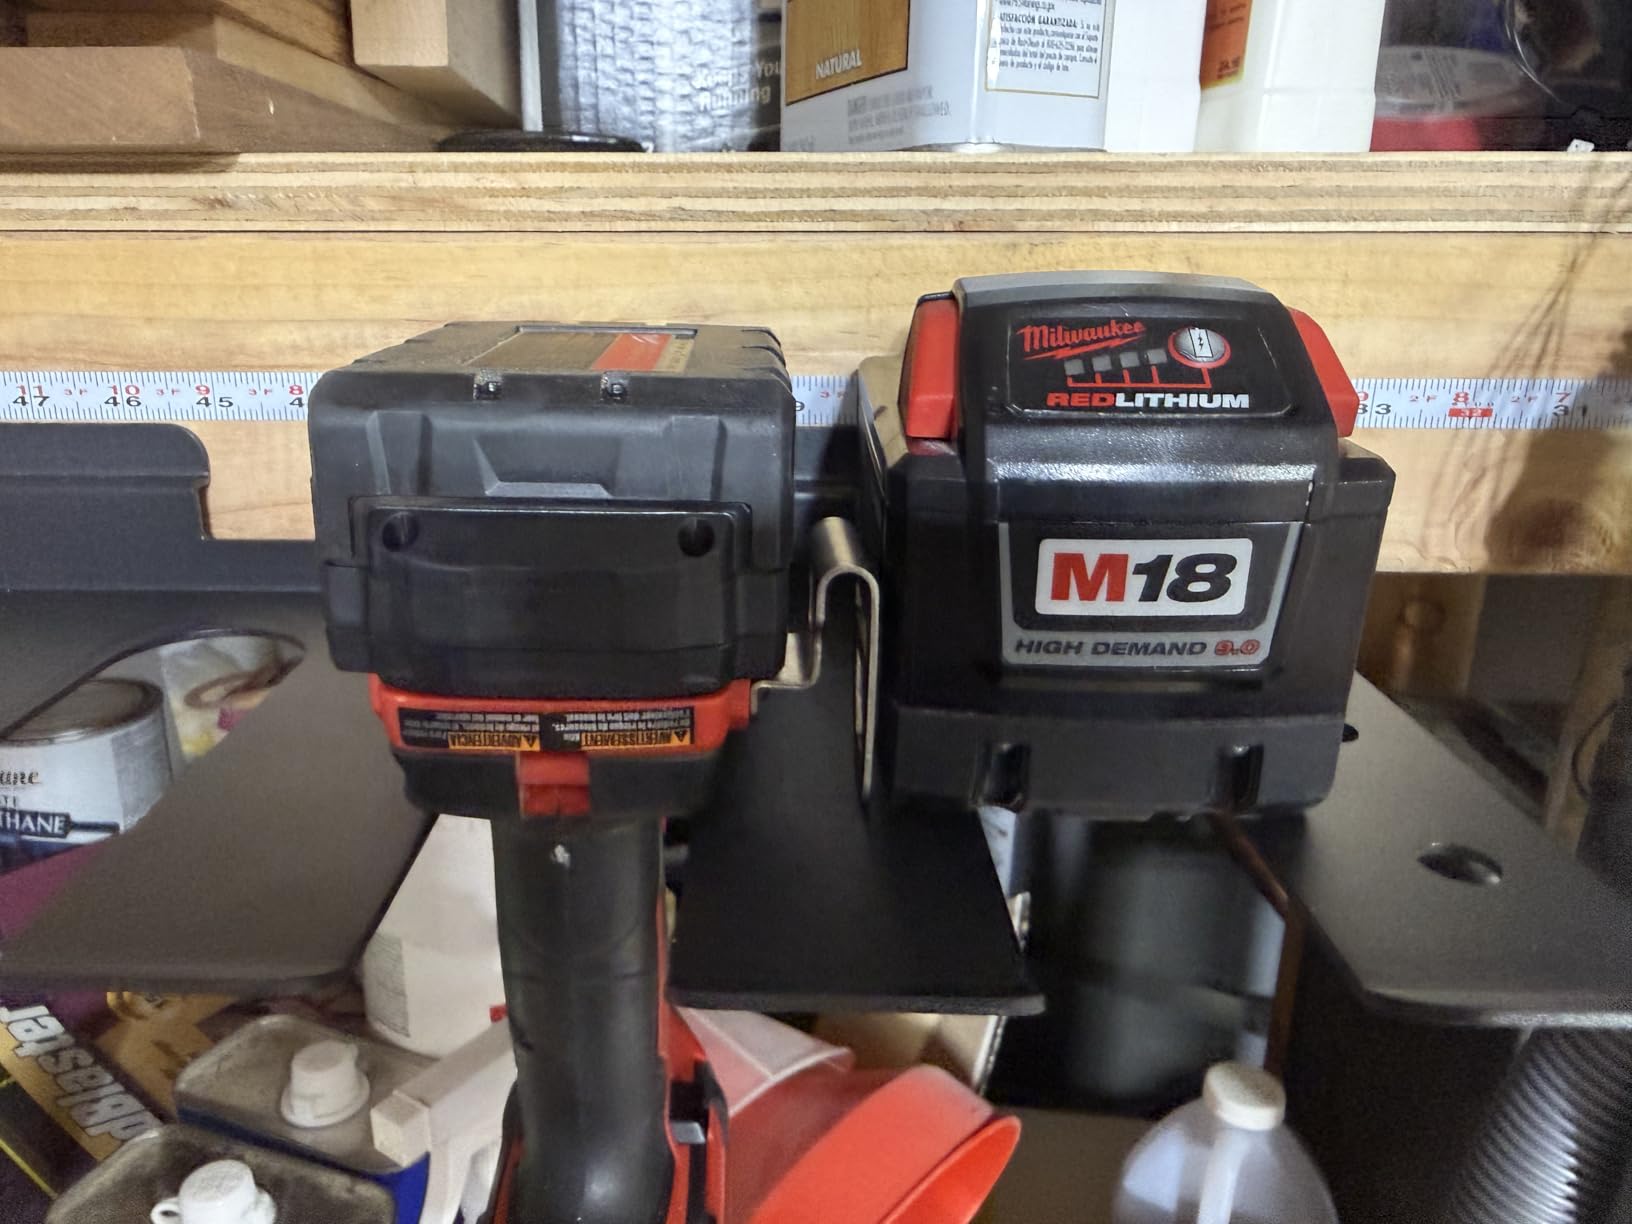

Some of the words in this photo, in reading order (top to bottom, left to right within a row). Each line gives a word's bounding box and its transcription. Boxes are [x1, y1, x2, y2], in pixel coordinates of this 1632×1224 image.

[815, 48, 862, 80] NATURAL
[1016, 319, 1147, 354] Milwaukee
[288, 384, 305, 396] 8
[12, 395, 50, 407] 47
[104, 395, 143, 408] 46
[196, 395, 235, 408] 45
[1046, 392, 1250, 409] REDLITHIUM
[1051, 552, 1238, 603] M18
[1015, 639, 1084, 656] HIGH
[1091, 640, 1208, 656] DEMAND
